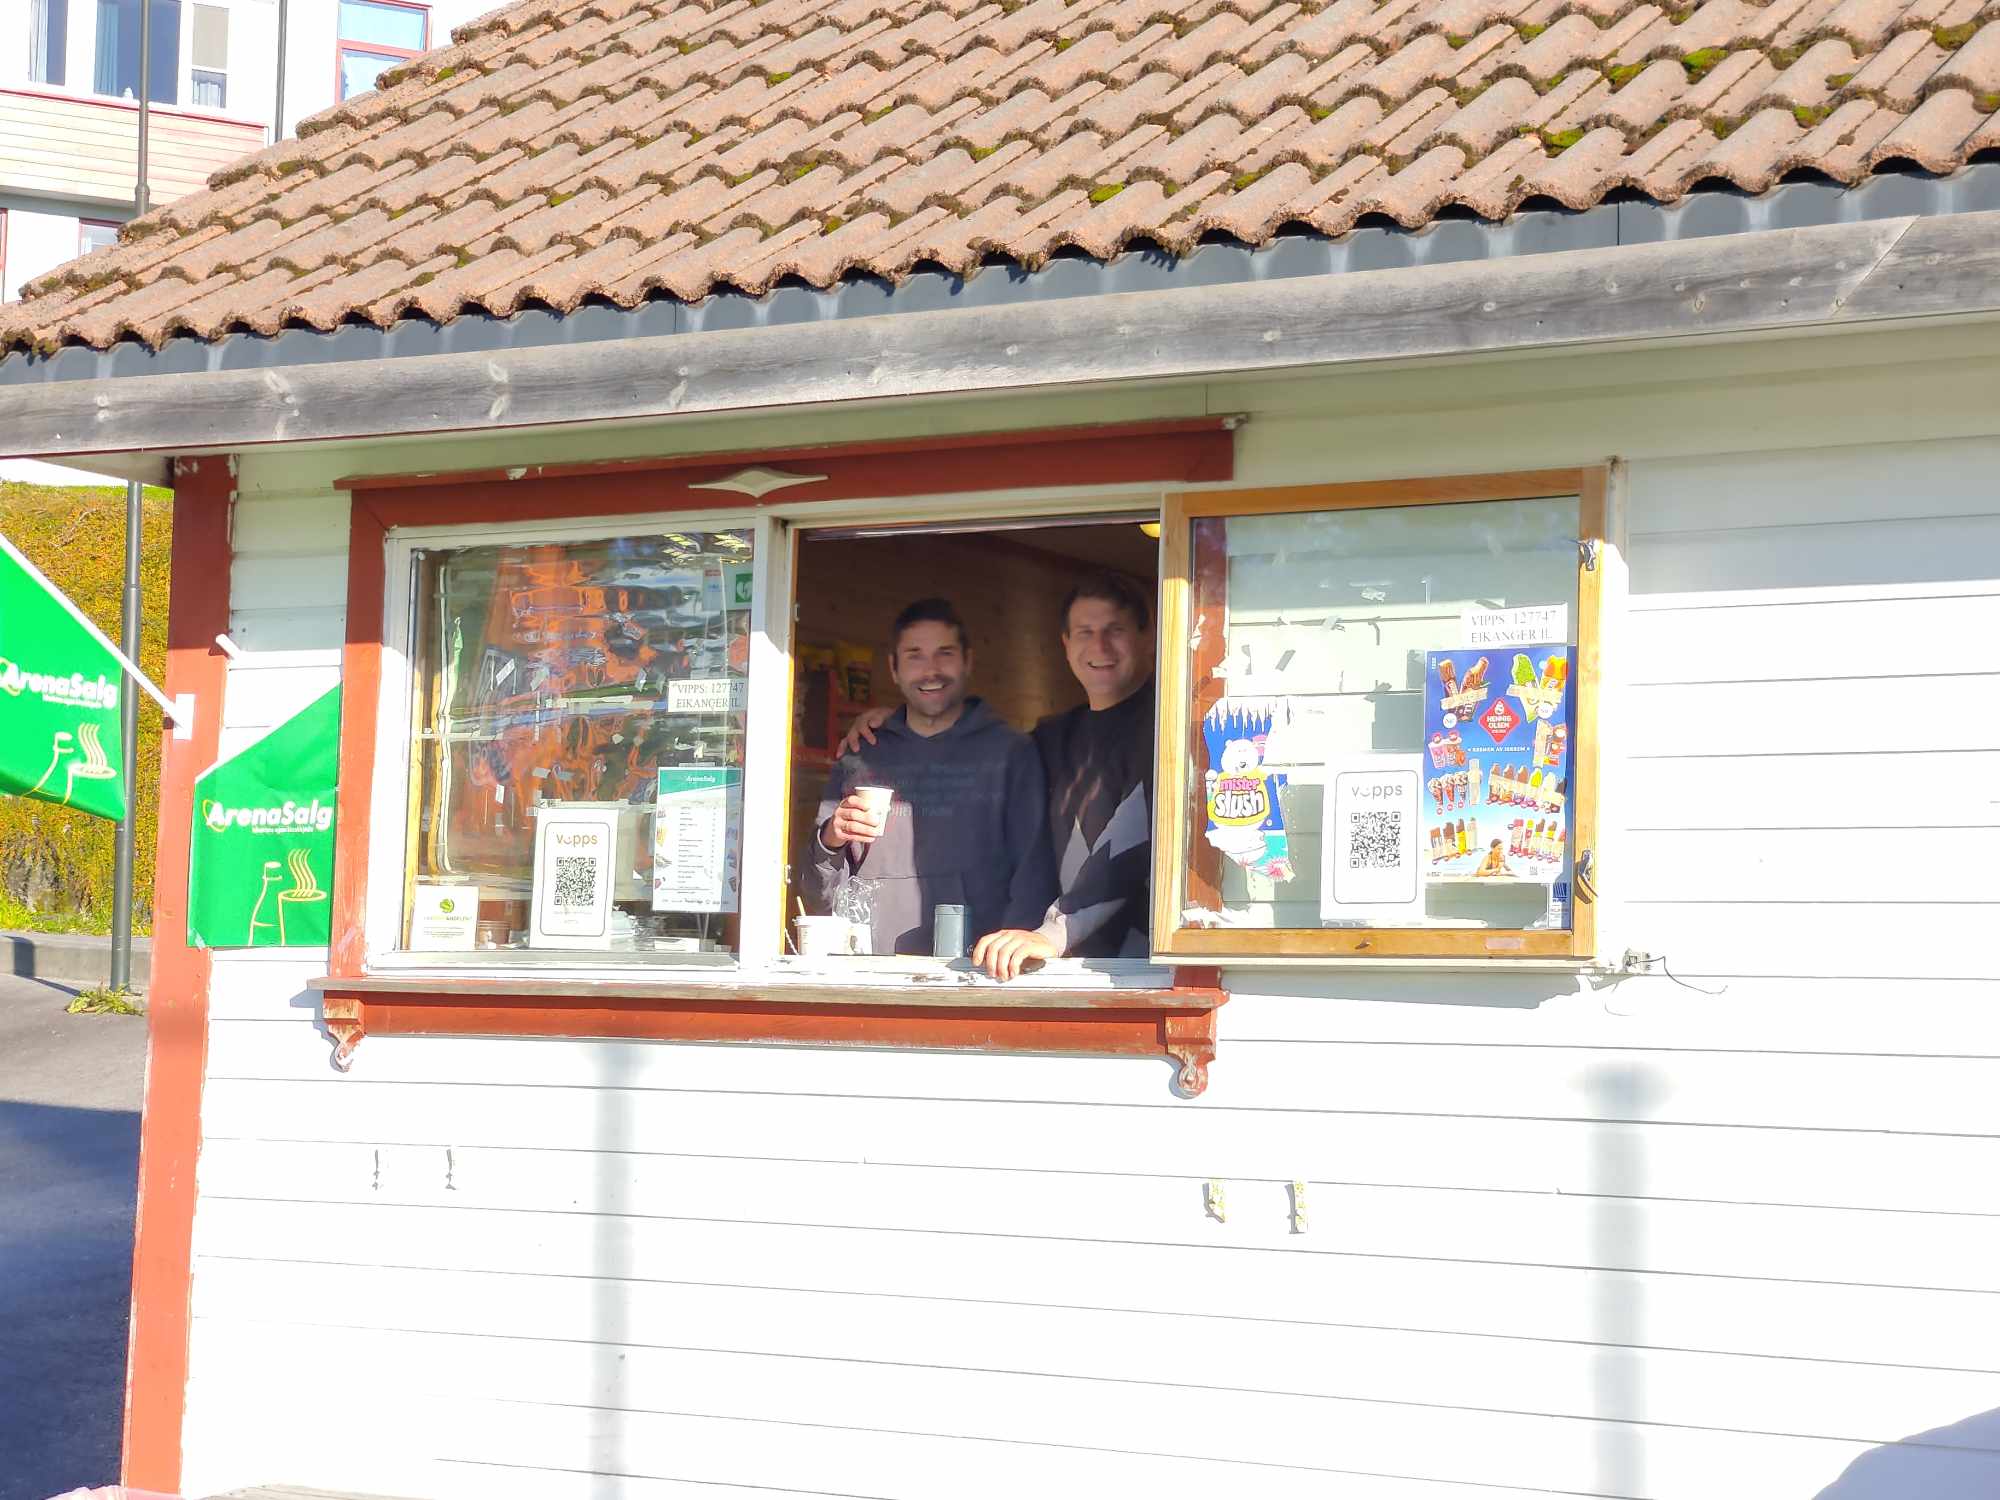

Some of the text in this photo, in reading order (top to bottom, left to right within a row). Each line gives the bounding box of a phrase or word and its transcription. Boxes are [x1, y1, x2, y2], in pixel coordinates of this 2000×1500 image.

[1514, 609, 1557, 625] 127747
[1471, 629, 1536, 643] EIKANGER
[0, 662, 118, 709] ArenaSalg
[676, 697, 729, 709] EIKANGER
[1486, 715, 1512, 723] HENNIG
[1488, 722, 1510, 730] OLSEN
[1219, 776, 1260, 792] mister
[1214, 790, 1265, 819] slush
[206, 798, 333, 831] ArenaSalg
